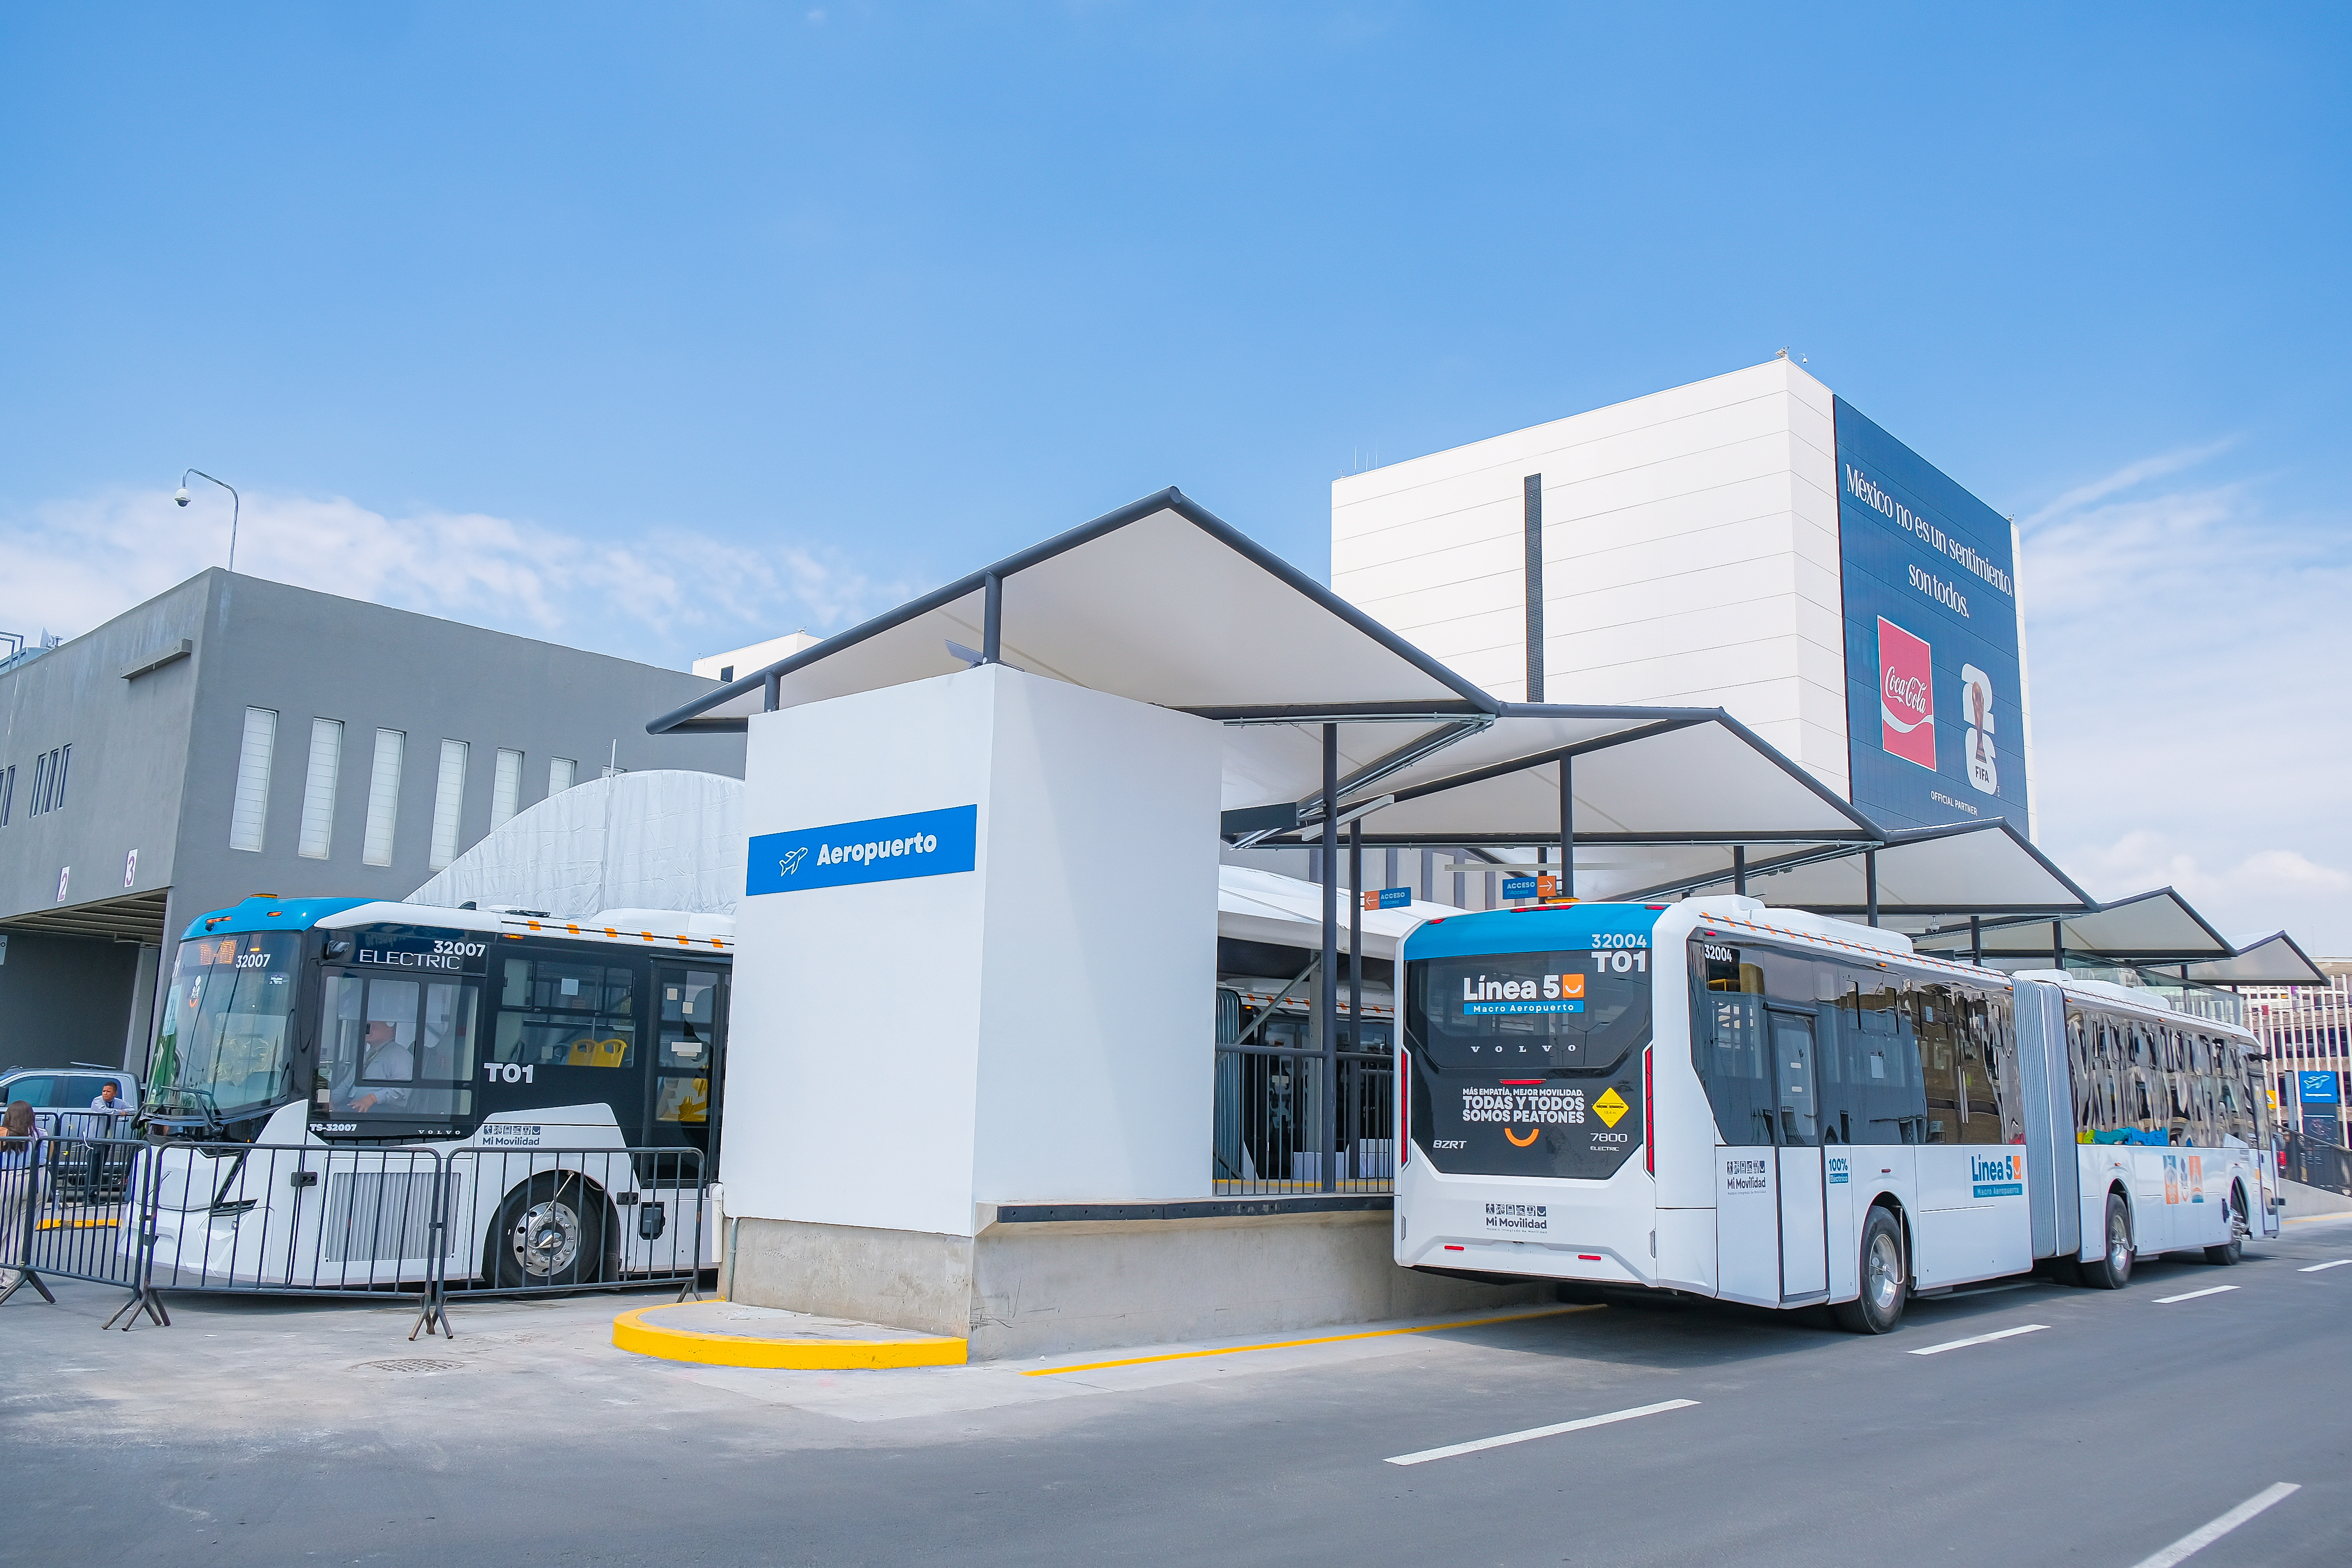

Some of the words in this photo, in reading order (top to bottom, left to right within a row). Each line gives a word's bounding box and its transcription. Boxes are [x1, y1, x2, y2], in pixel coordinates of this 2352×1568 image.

[1846, 463, 1893, 518] México
[1896, 502, 1913, 531] no
[1915, 516, 1929, 543] es
[1931, 526, 1947, 554] un
[1949, 538, 2013, 597] sentimiento.
[1909, 564, 1932, 597] son
[1933, 575, 1969, 618] todos.
[1885, 666, 1927, 714] Coca-Cola
[1975, 765, 1989, 783] FIFA
[1931, 790, 1954, 807] OFFICIAL
[1954, 799, 1978, 816] PARTNER
[816, 832, 937, 865] Aeropuerto
[126, 856, 135, 886] 3
[58, 873, 68, 900] 2
[434, 941, 486, 957] 32007
[1591, 934, 1647, 948] 32004
[236, 954, 271, 968] 32007
[360, 949, 460, 969] ELECTRIC
[1704, 944, 1732, 962] 32004
[1464, 975, 1537, 1000] Línea
[1543, 975, 1559, 999] 5
[1509, 1003, 1574, 1014] Aeropuerto
[1463, 1087, 1478, 1096] MÁS
[1463, 1096, 1513, 1109] TODAS
[1516, 1096, 1526, 1109] Y
[1529, 1096, 1585, 1111] TODOS
[1463, 1109, 1510, 1122] SOMOS
[1513, 1110, 1585, 1124] PEATONES
[483, 1137, 493, 1145] Mi
[495, 1137, 540, 1146] Movilidad
[1433, 1140, 1467, 1149] BZRT
[1590, 1133, 1628, 1142] 7800
[1828, 1158, 1848, 1171] 100%
[1971, 1154, 2004, 1181] Línea
[2006, 1156, 2013, 1180] 5
[1727, 1177, 1735, 1189] Mi
[1736, 1176, 1766, 1189] Movilidad
[1486, 1216, 1497, 1226] Mi
[1499, 1218, 1547, 1229] Movilidad
